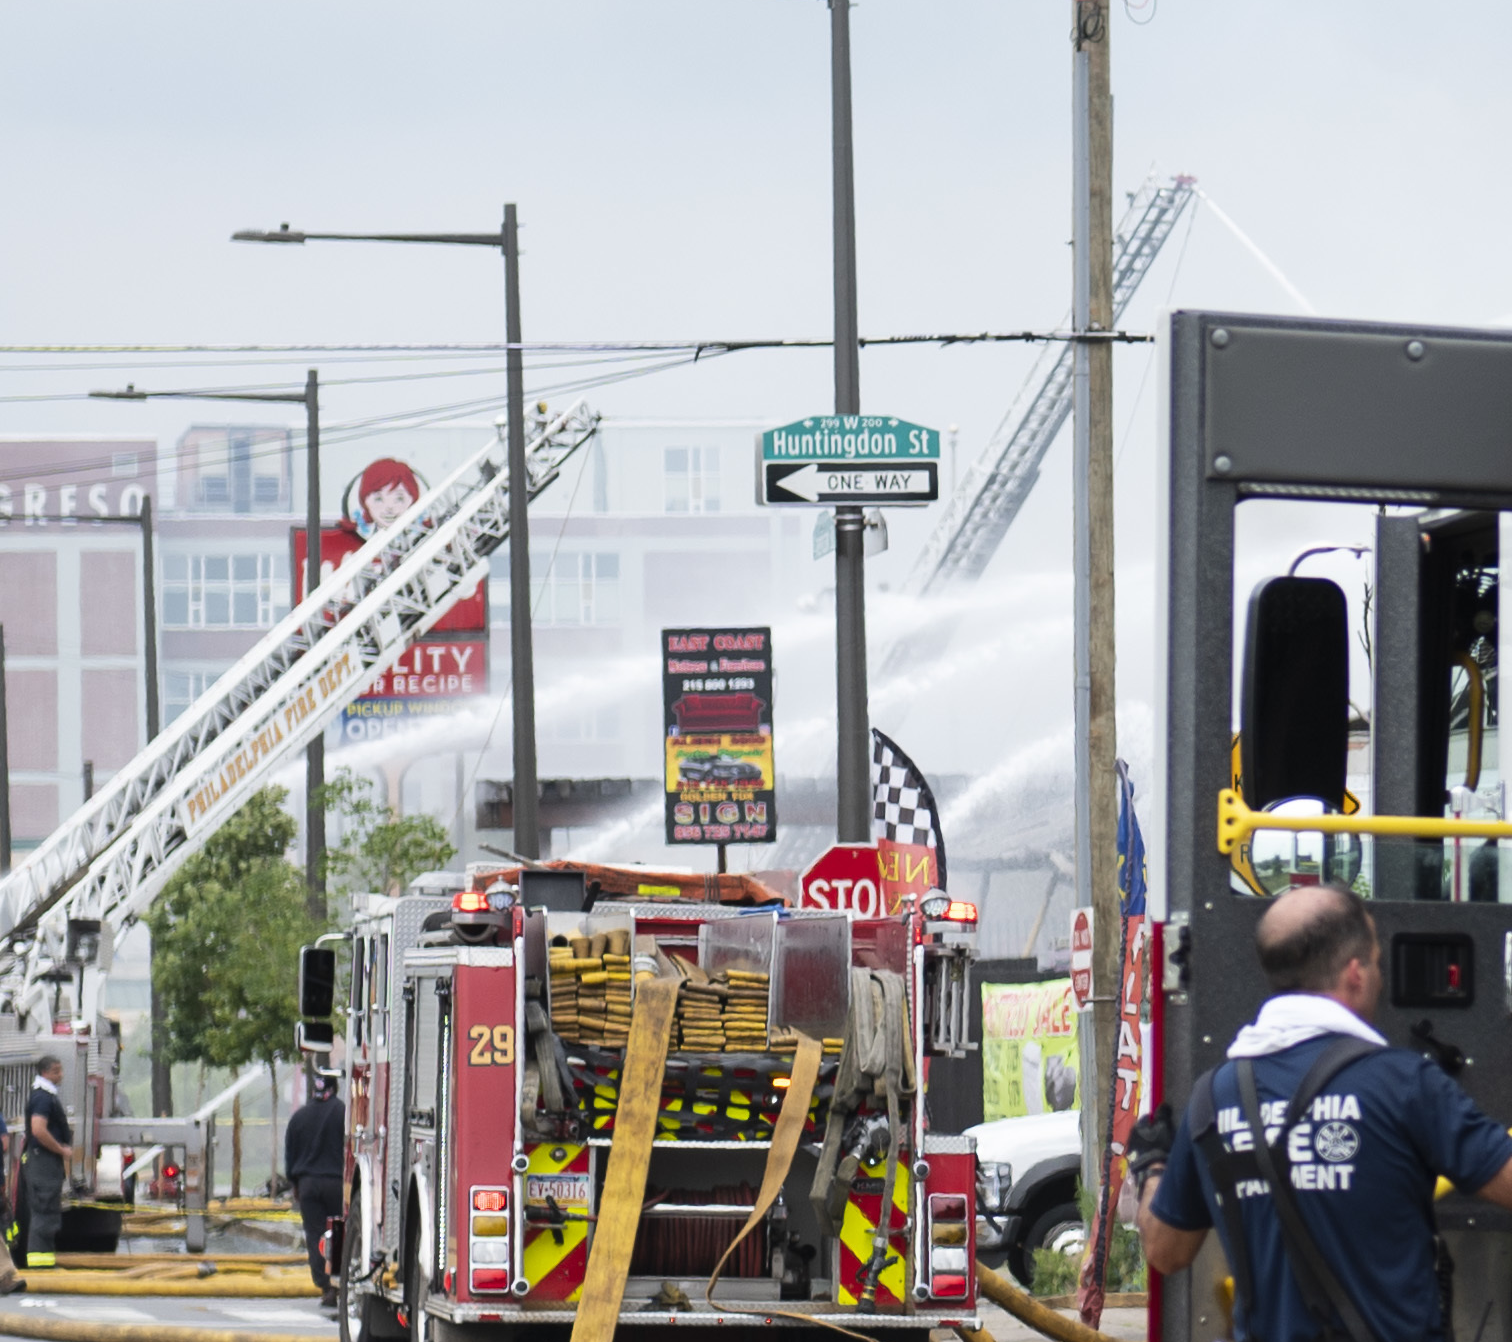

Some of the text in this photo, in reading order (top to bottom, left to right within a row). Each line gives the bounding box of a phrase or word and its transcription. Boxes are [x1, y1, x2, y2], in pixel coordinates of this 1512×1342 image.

[843, 417, 859, 430] W
[861, 418, 883, 428] 200
[773, 430, 930, 458] Huntingdon St
[827, 474, 912, 491] ONE WAY
[668, 633, 765, 653] EAST COAST
[393, 674, 473, 693] RECIPE
[347, 701, 403, 717] PICKUP
[187, 721, 284, 824] PHILADELPHIA
[283, 685, 317, 732] FIRE
[674, 801, 767, 825] SIGN
[808, 878, 888, 919] STO
[468, 1024, 515, 1067] 29
